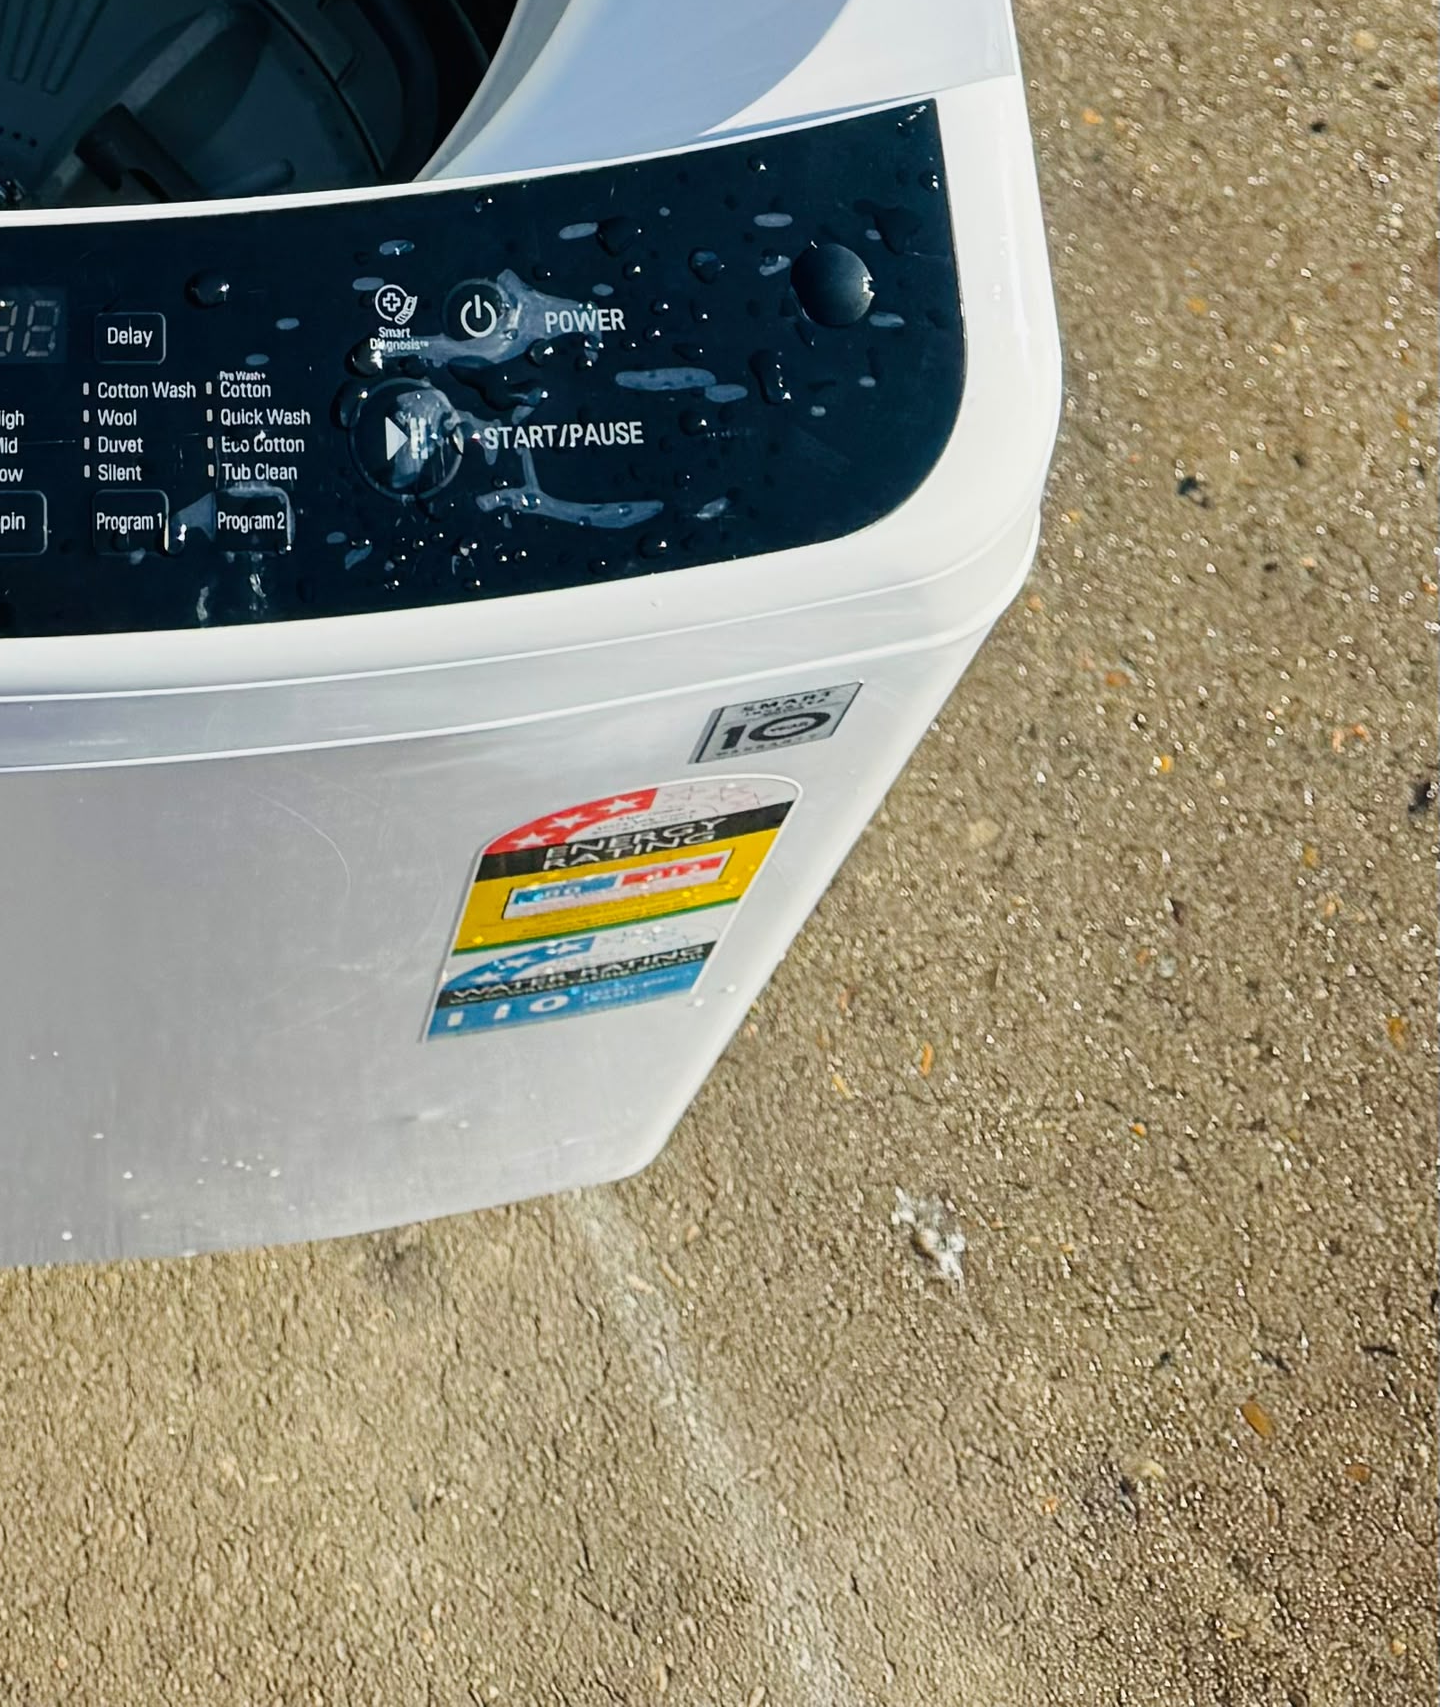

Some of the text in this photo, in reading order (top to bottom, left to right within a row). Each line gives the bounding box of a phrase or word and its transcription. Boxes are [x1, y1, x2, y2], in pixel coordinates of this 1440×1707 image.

[544, 308, 626, 334] POWER
[107, 326, 154, 348] Delay
[378, 326, 411, 339] Smart
[97, 381, 197, 399] Cotton Wash
[220, 381, 272, 398] Cotton
[97, 408, 137, 427] Wool
[220, 408, 311, 427] Quick Wash
[97, 436, 144, 454] Duvet
[221, 435, 305, 453] Eco Cotton
[483, 420, 644, 451] START/PAUSE
[97, 463, 143, 482] Silent
[221, 463, 299, 481] Tub Clean
[96, 511, 164, 532] Program 1
[217, 511, 286, 532] Program 2
[720, 711, 832, 751] 10
[547, 816, 729, 859] ENERGY
[541, 834, 715, 872] RATING
